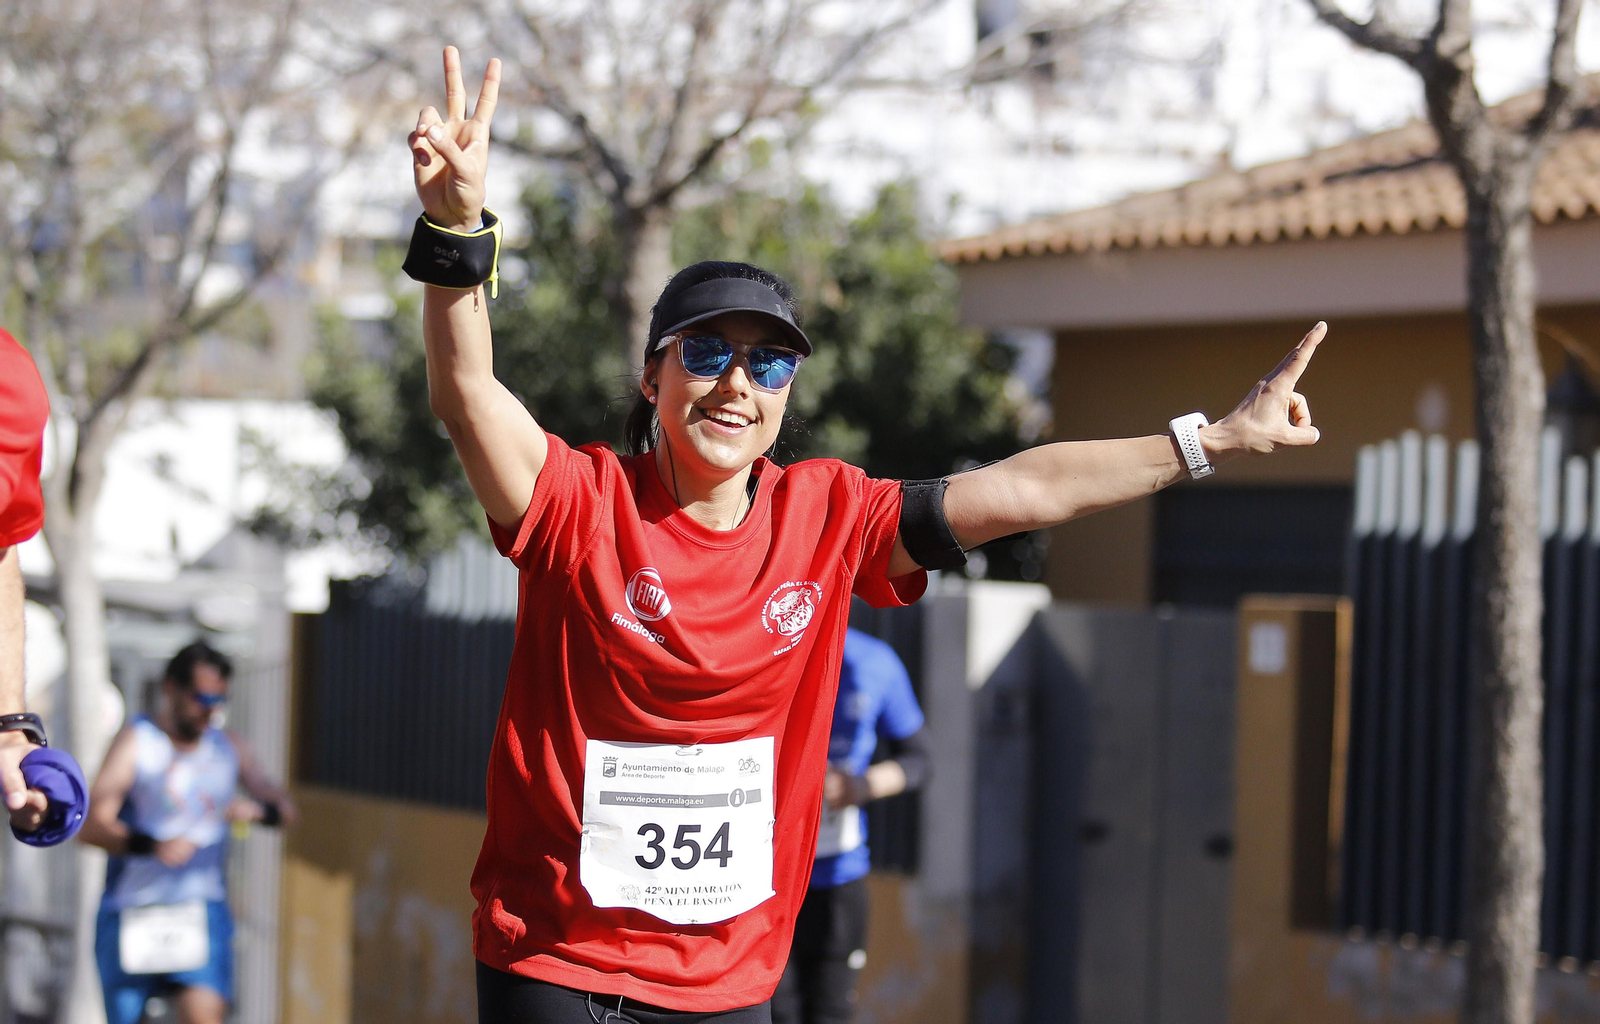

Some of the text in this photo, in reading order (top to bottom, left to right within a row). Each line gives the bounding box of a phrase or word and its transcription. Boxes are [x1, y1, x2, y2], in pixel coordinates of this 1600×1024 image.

[636, 580, 665, 610] FIAT
[611, 612, 666, 644] Fimálaga
[621, 763, 682, 773] Ayuntamiento
[684, 766, 695, 774] de
[738, 758, 761, 773] 2020
[615, 795, 704, 806] www.deporte.malaga.eu
[634, 822, 733, 870] 354
[664, 886, 690, 895] MINI
[644, 896, 673, 906] PEÑA
[677, 898, 690, 906] EL
